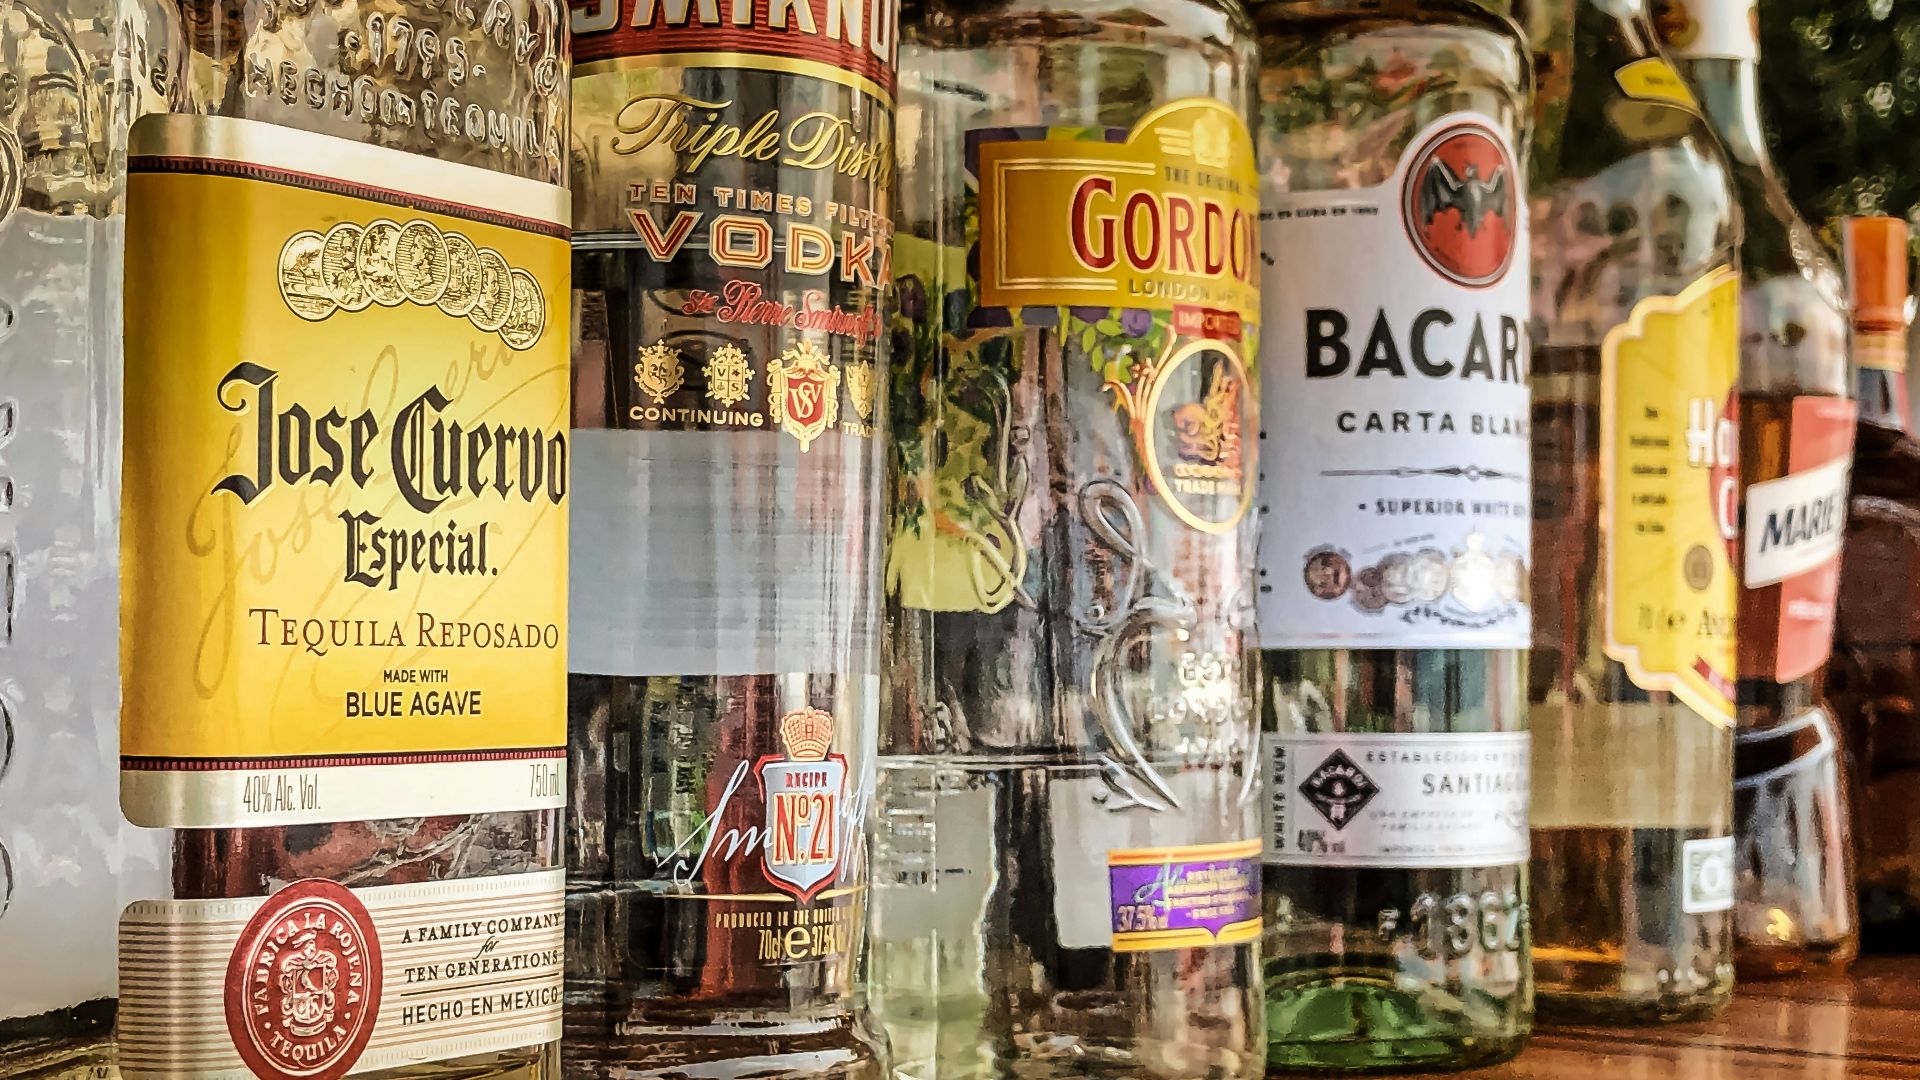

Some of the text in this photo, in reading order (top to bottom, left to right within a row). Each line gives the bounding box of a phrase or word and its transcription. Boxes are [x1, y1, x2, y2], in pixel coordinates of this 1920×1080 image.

[610, 93, 780, 174] Triple
[628, 181, 697, 205] TEN
[713, 186, 813, 216] TIMES
[629, 406, 763, 426] CONTINUING
[1337, 411, 1455, 433] CARTA
[210, 361, 379, 506] Jose
[391, 384, 567, 514] Cuervo
[338, 509, 499, 591] Especial.
[249, 608, 560, 657] TEQUILA REPOSADO
[383, 669, 448, 684] MADE WITH
[346, 690, 481, 717] BLUE AGAVE
[243, 773, 321, 813] 40% Alc. Vol.
[530, 763, 560, 798] 750 ml
[786, 772, 828, 788] RECIPE
[303, 912, 327, 929] LA
[402, 912, 561, 944] A FAMILY COMPANY
[715, 911, 772, 929] PRODUCED
[777, 911, 789, 927] IN
[793, 909, 810, 926] THE
[472, 936, 500, 959] for
[758, 928, 781, 960] 70cl
[784, 926, 811, 959] e
[404, 949, 559, 983] TEN GENERATIONS
[402, 986, 559, 1025] HECHO EN MEXICO
[269, 1025, 347, 1061] TEQUILA
